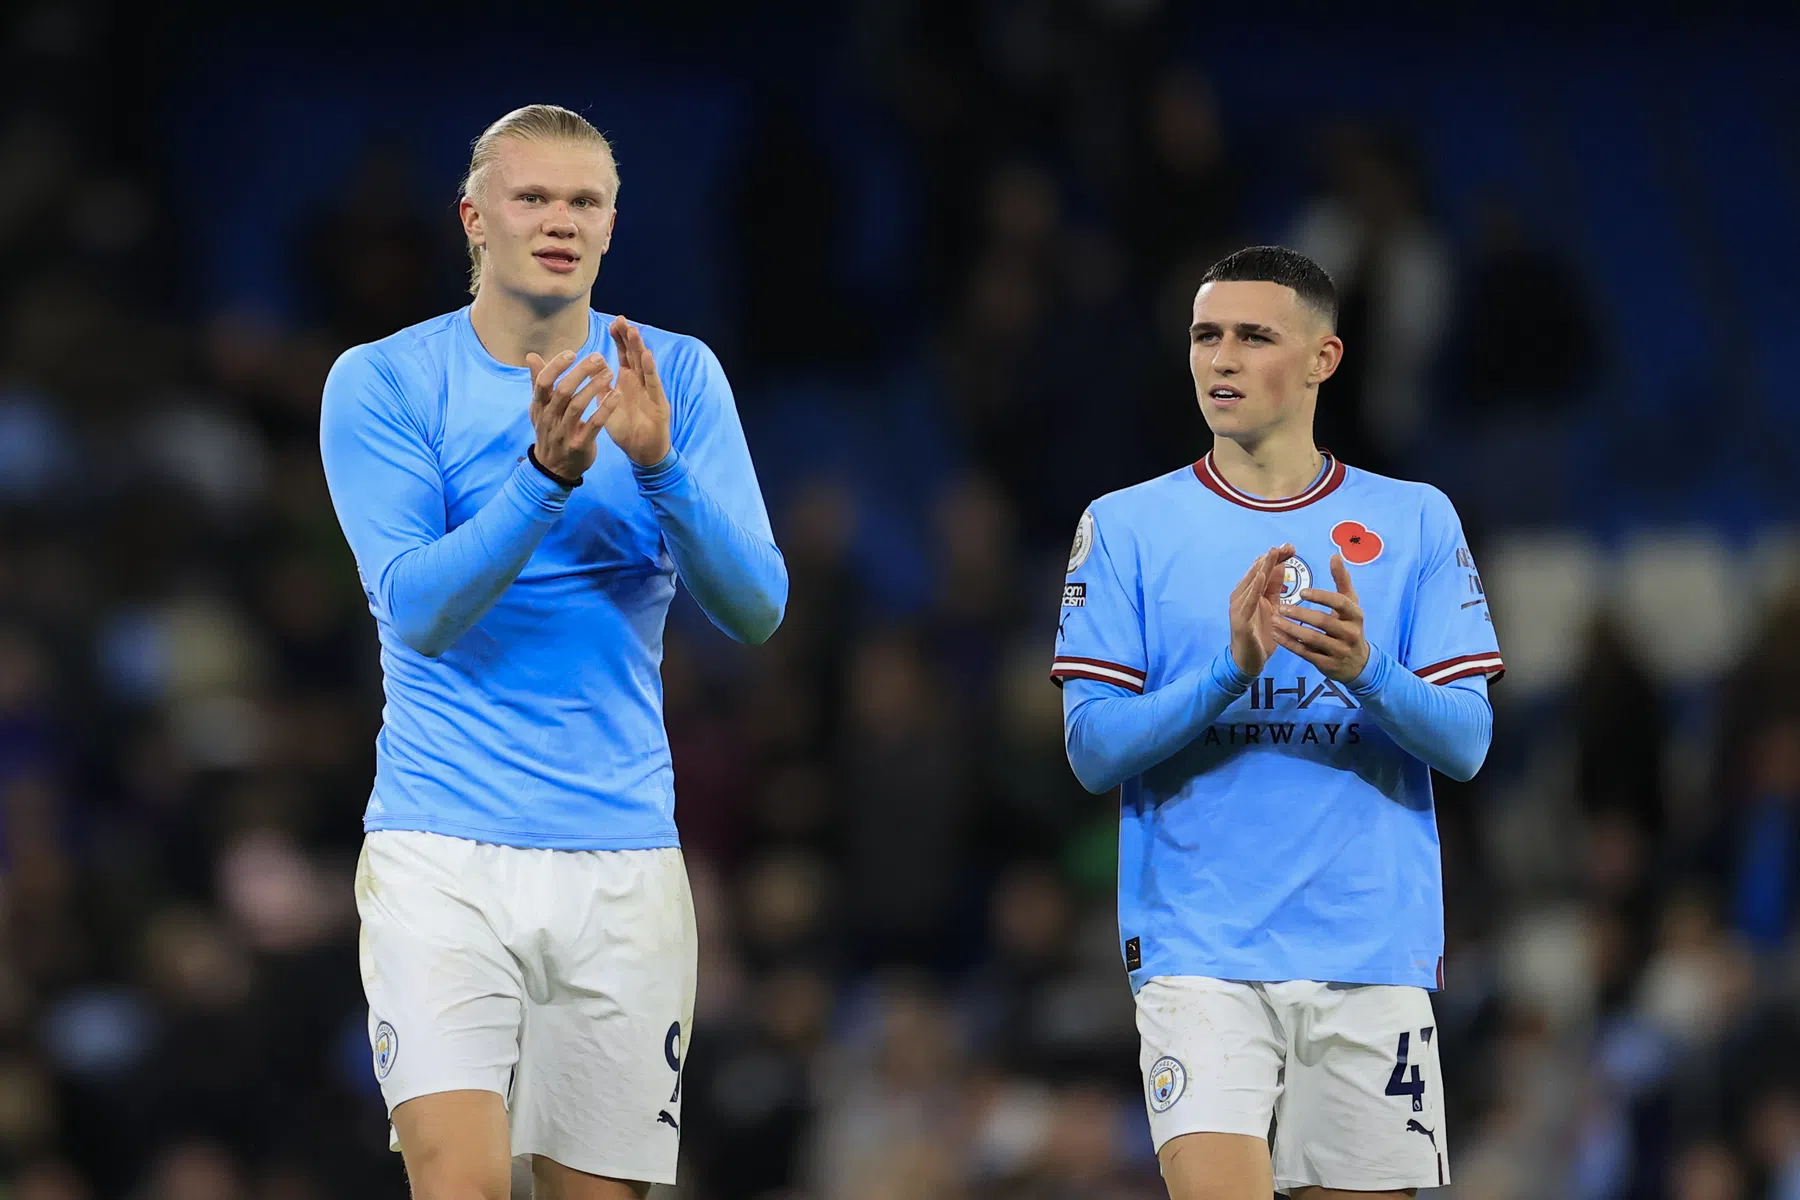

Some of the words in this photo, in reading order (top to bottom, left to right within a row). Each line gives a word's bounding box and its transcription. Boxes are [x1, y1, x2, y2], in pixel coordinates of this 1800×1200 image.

[1250, 676, 1359, 710] IHA
[1204, 724, 1361, 746] AIRWAYS
[1160, 1100, 1171, 1109] CITY
